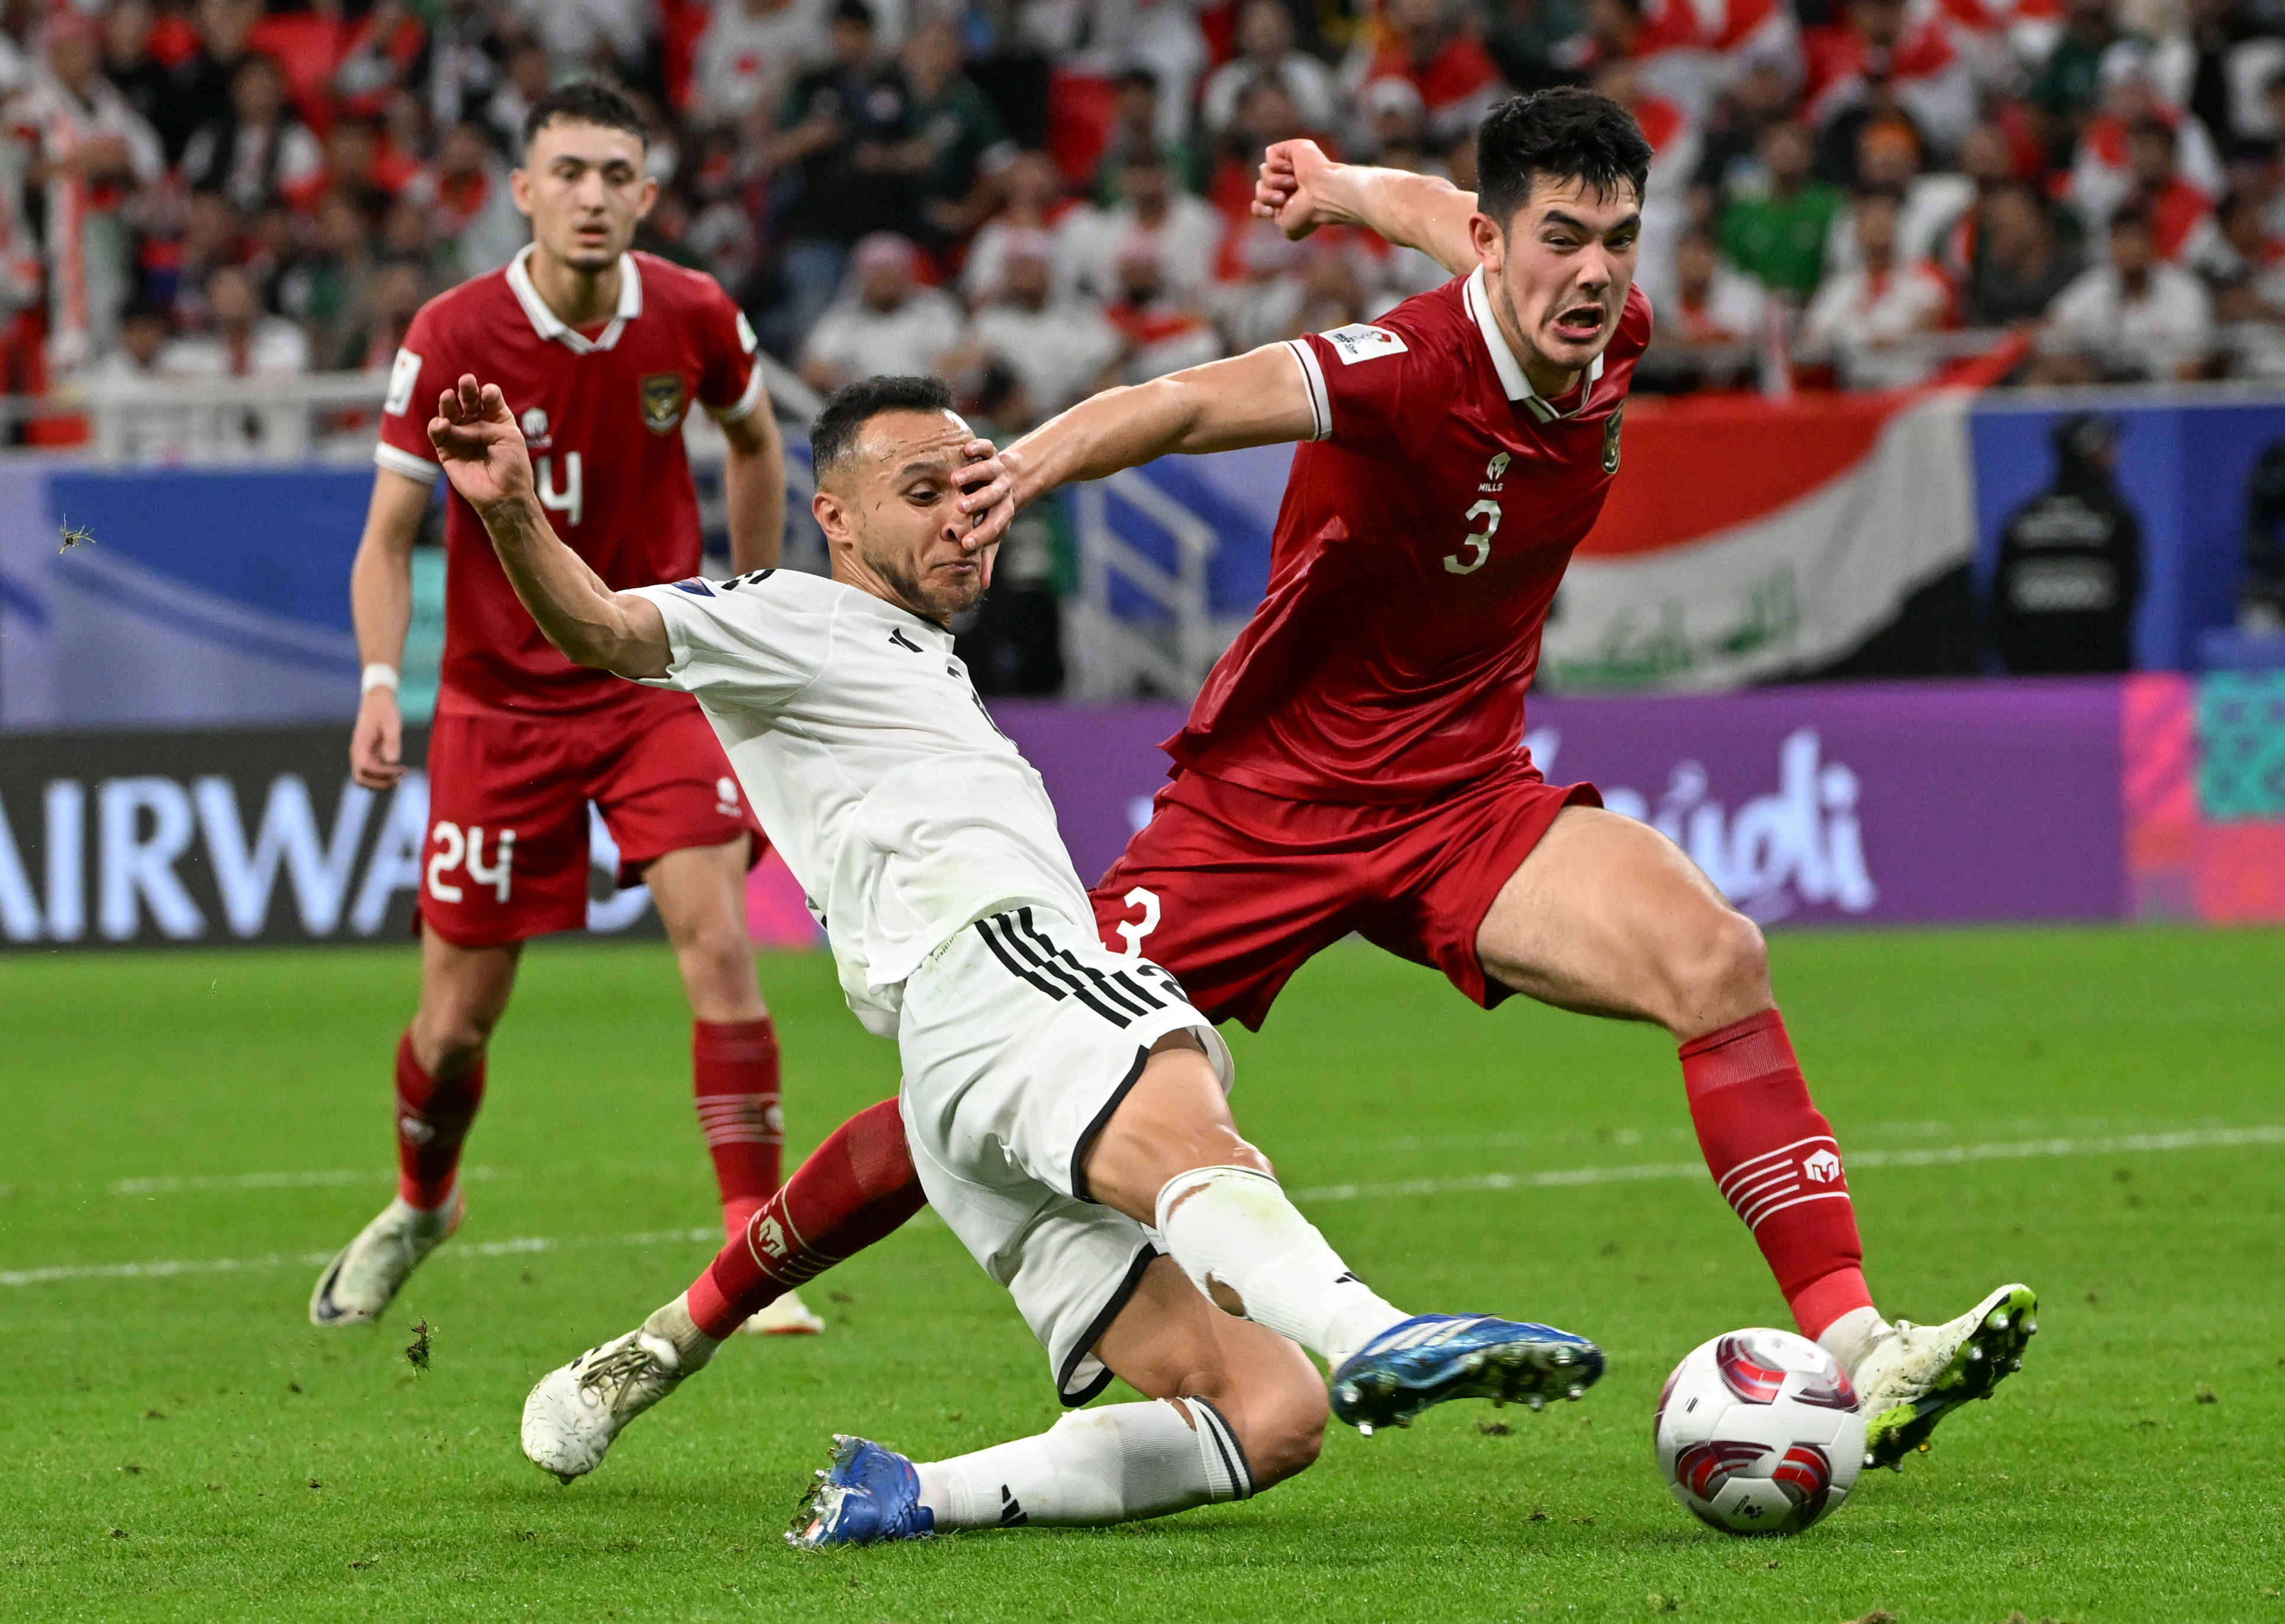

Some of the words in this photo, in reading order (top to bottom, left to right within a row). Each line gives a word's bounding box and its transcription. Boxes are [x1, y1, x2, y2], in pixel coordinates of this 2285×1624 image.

[535, 450, 583, 527] 4
[1478, 483, 1504, 492] MILLS
[1443, 499, 1502, 575] 3
[427, 820, 517, 904] 24
[1101, 886, 1161, 959] 3
